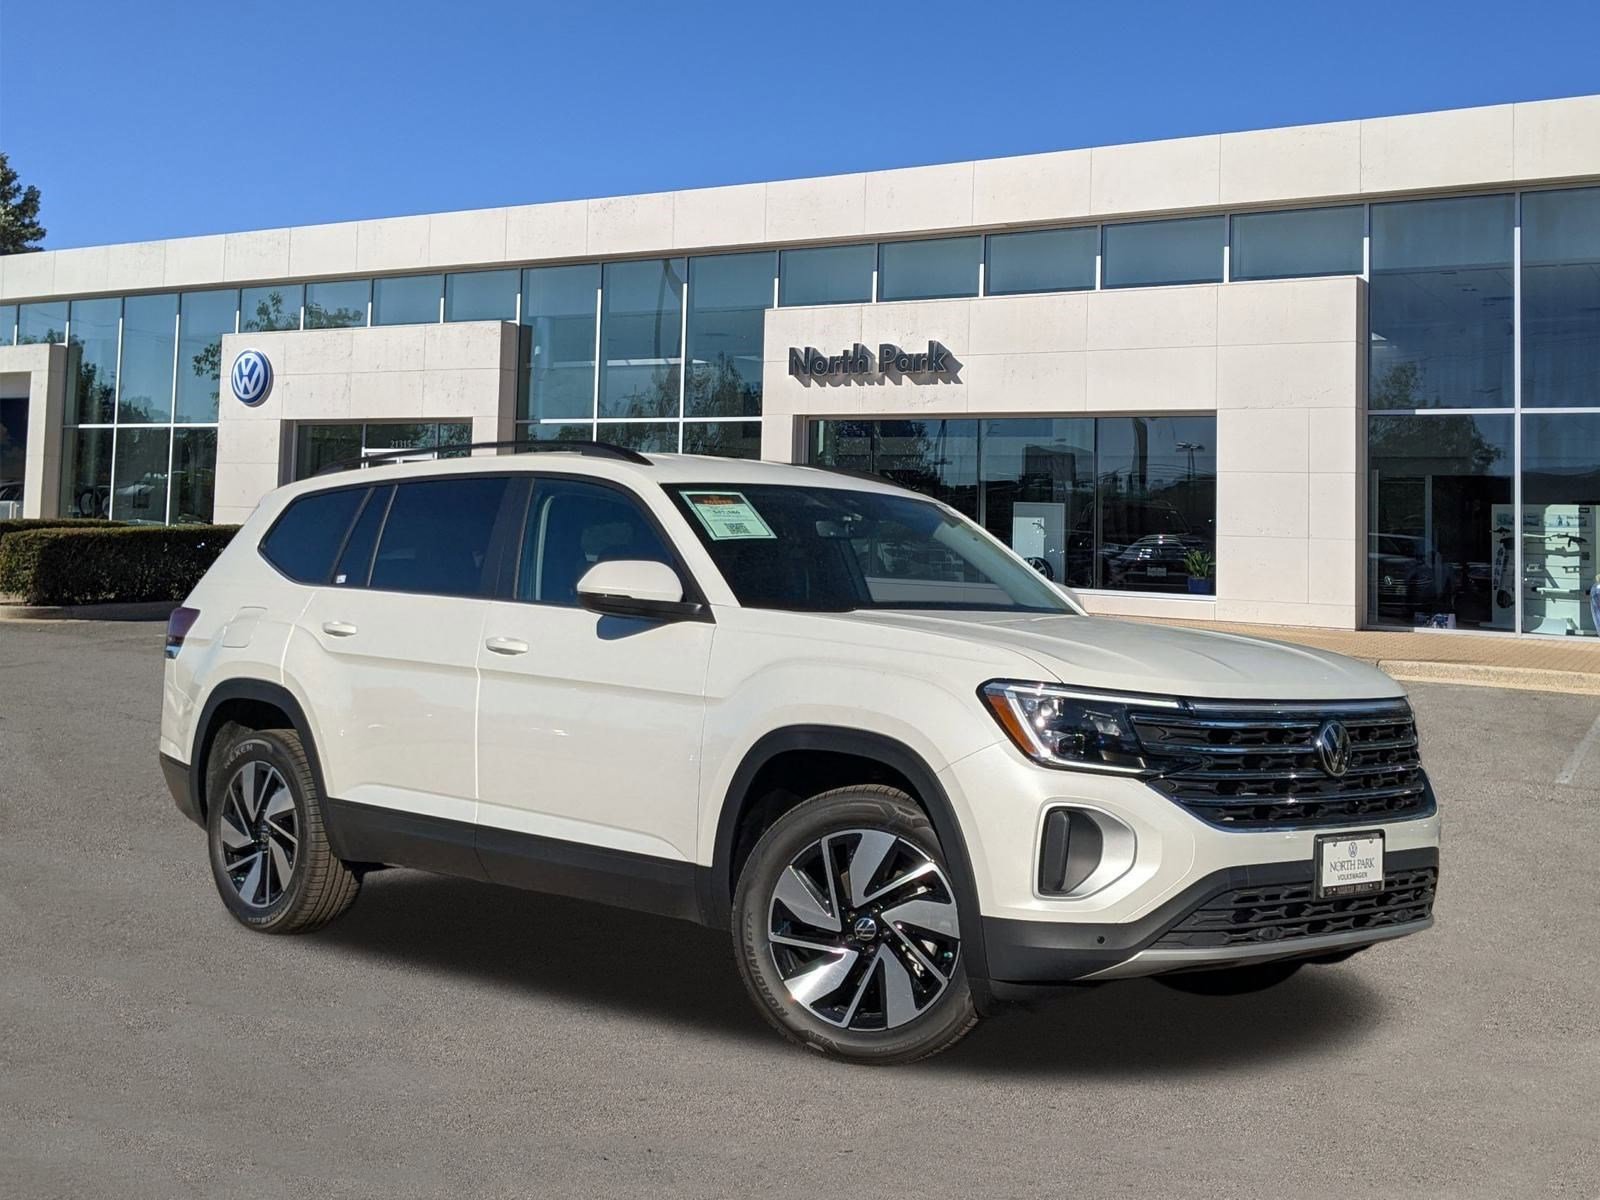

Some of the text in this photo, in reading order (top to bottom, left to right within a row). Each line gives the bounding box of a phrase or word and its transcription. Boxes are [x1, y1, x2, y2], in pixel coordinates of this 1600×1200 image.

[788, 340, 948, 376] North Park
[1329, 857, 1376, 872] NORTH PARK
